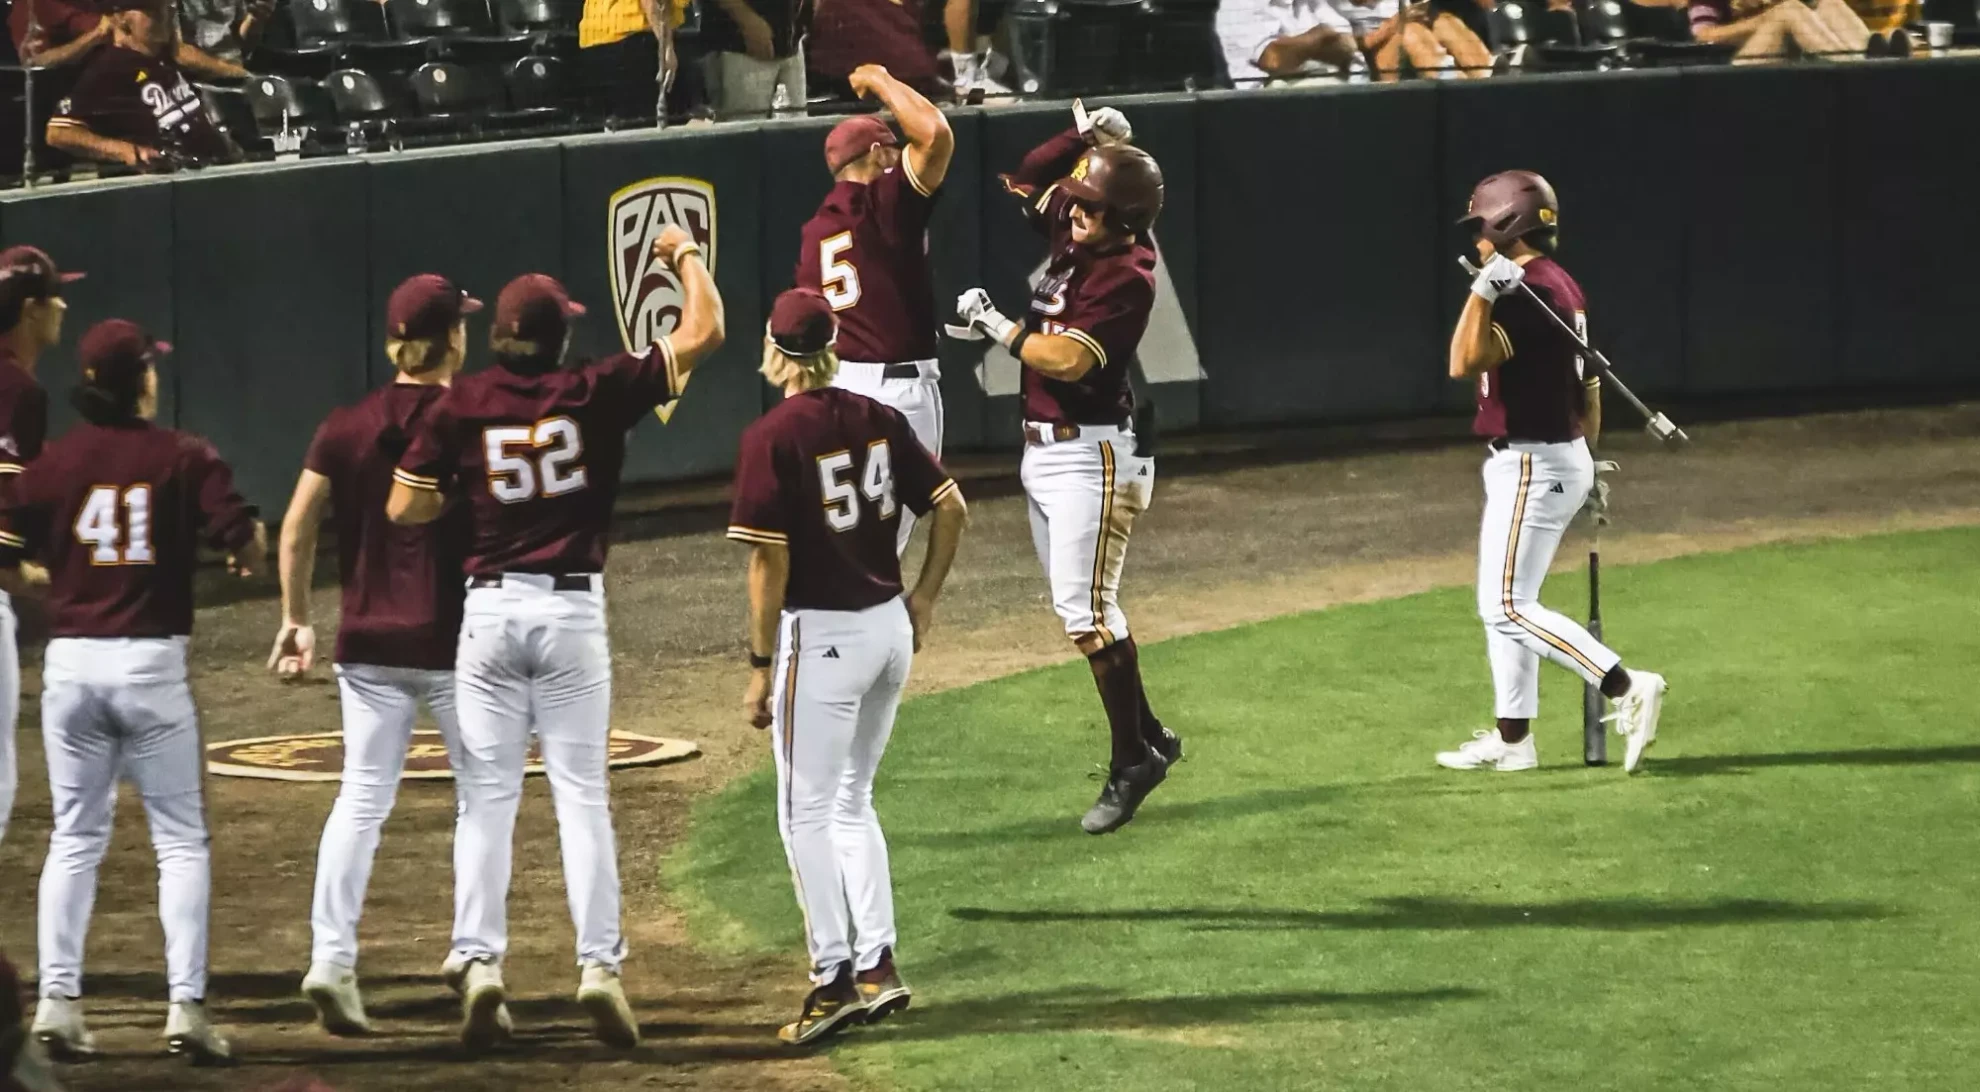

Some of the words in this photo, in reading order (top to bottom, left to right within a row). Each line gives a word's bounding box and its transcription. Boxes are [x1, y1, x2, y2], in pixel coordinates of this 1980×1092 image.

[616, 191, 708, 316] PAC
[820, 230, 861, 312] 5
[482, 415, 588, 504] 52
[816, 439, 896, 533] 54
[73, 483, 156, 566] 41
